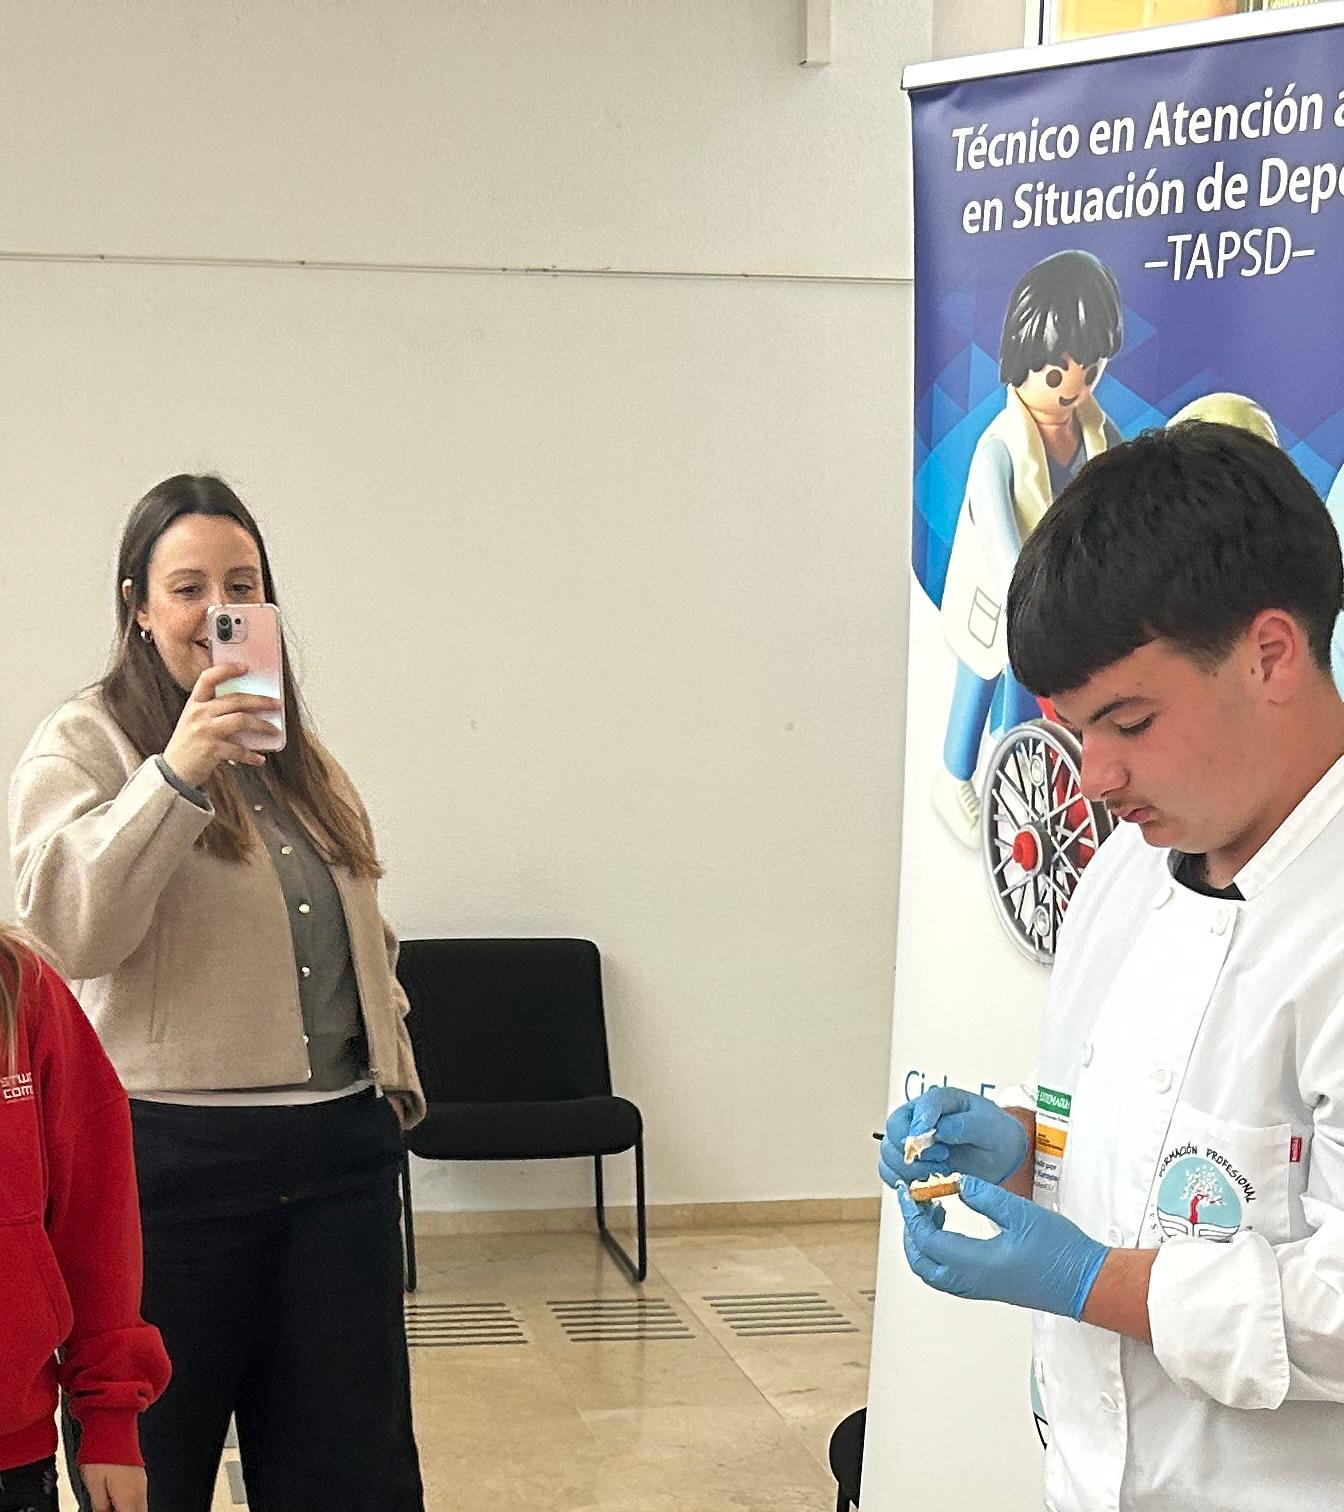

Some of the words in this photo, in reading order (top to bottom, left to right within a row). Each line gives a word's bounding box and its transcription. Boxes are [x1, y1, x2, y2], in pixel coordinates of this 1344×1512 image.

[952, 117, 1079, 171] Técnico
[1090, 116, 1135, 155] en
[1144, 82, 1323, 149] Atención
[963, 197, 1003, 233] en
[1013, 168, 1184, 229] Situación
[1197, 161, 1248, 211] de
[1206, 1149, 1256, 1203] PROFESIONAL
